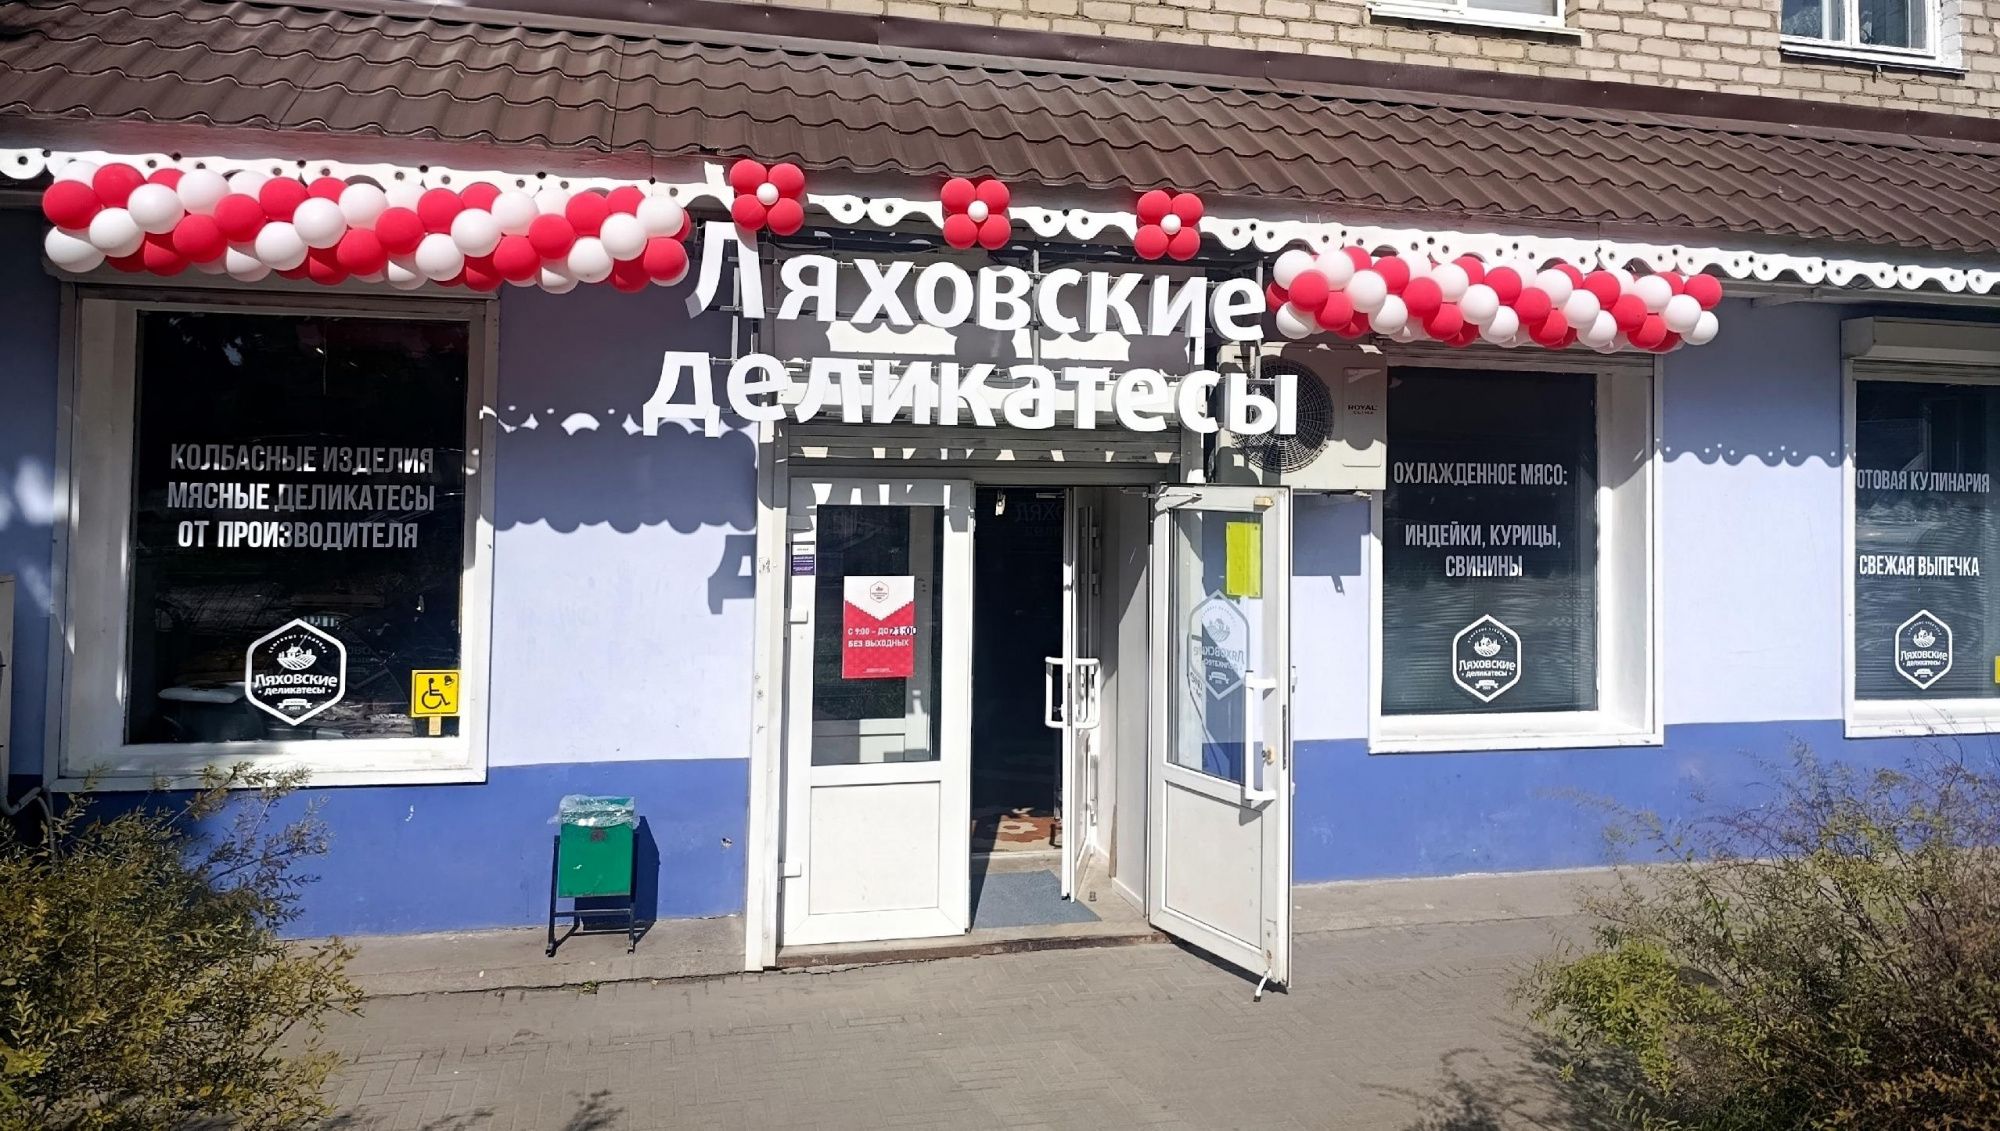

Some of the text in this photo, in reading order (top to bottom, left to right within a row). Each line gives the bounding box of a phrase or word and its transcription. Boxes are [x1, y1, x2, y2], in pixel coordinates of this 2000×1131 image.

[686, 221, 1266, 341] Ляховские
[642, 350, 1298, 437] деликатесы
[171, 443, 434, 475] КОЛБАСНЫЕ ИЗДЕЛИЯ
[1393, 462, 1568, 486] ОХЛАЖДЕННОЕ МЯСО:
[1856, 469, 1990, 493] ОТОВАЯ КУЛИНАРИЯ
[167, 481, 435, 513] МЯСНЫЕ ДЕЛИКАТЕСЫ
[178, 520, 418, 551] ОТ ПРОИЗВОДИТЕЛЯ
[1405, 521, 1561, 549] ИНДЕЙКИ, КУРИЦЫ,
[1445, 555, 1523, 577] СВИНИНЫ
[1859, 555, 1980, 577] СВЕЖАЯ ВЫПЕЧКА
[847, 638, 909, 648] БЕЗ ВЫХОДНЫХ
[1459, 659, 1516, 671] Ляховские
[1900, 650, 1948, 661] Ляховские
[254, 673, 338, 688] Ляховские
[264, 687, 326, 696] деликатесы
